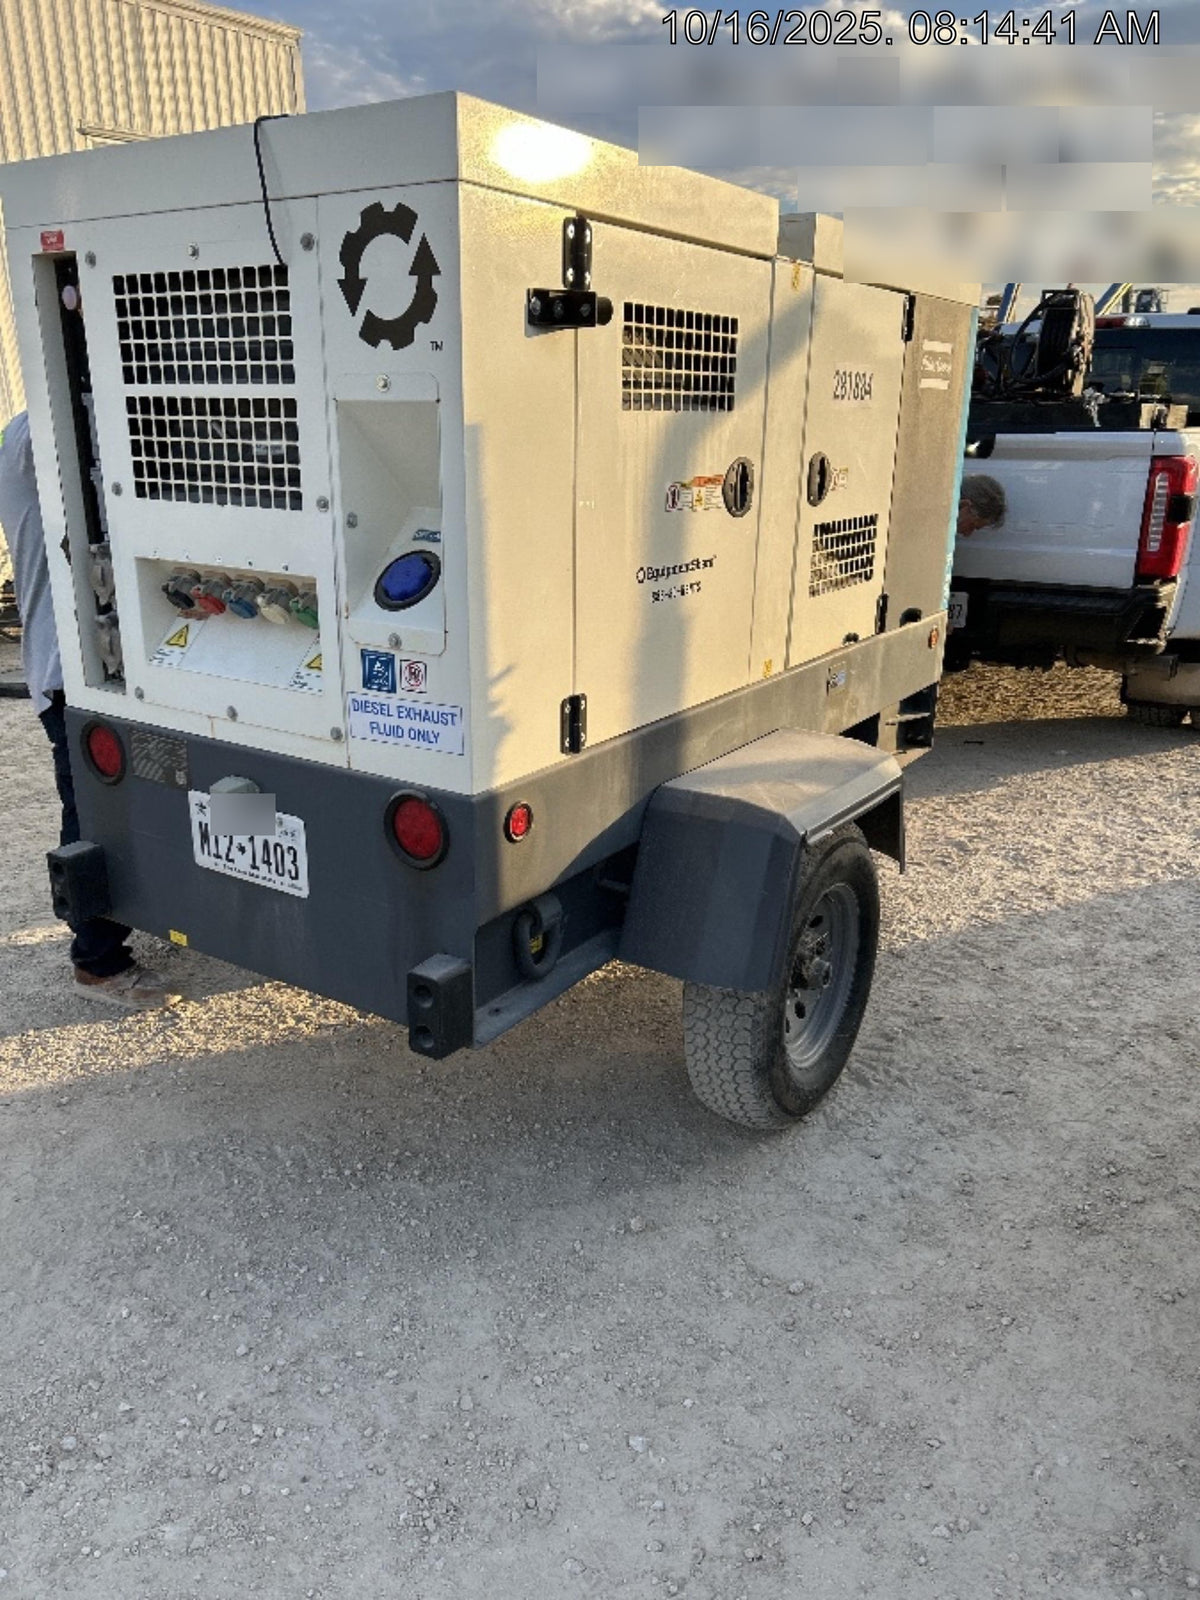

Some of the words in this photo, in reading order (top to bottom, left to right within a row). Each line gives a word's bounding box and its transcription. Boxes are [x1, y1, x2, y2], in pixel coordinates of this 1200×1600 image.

[351, 698, 394, 717] DIESEL
[396, 704, 458, 727] EXHAUST
[369, 721, 404, 739] FLUID
[408, 726, 440, 744] ONLY
